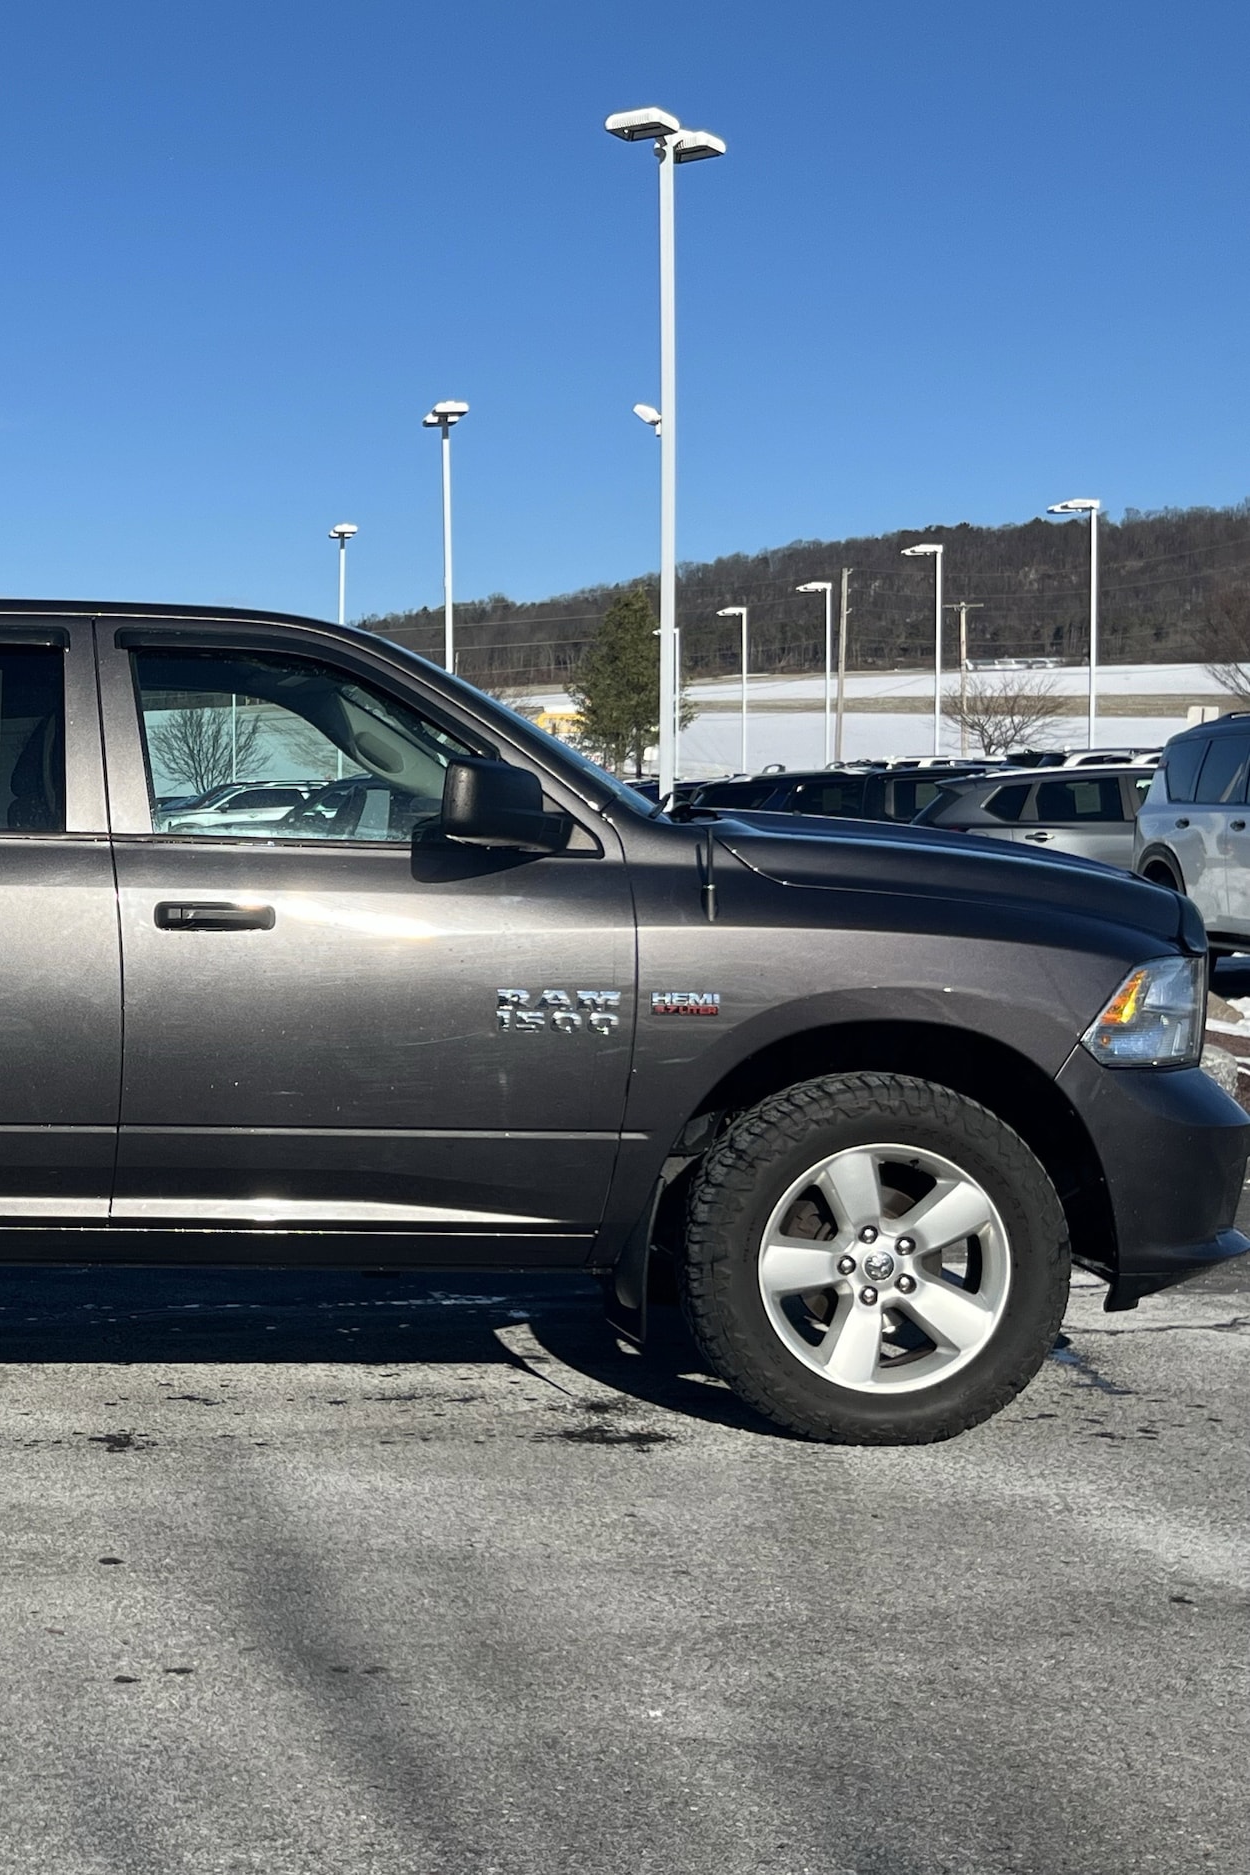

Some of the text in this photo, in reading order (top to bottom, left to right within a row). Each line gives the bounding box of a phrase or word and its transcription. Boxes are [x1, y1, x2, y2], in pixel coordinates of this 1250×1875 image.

[496, 989, 622, 1011] RAM
[652, 992, 720, 1006] HEMI
[495, 1011, 620, 1035] 1500
